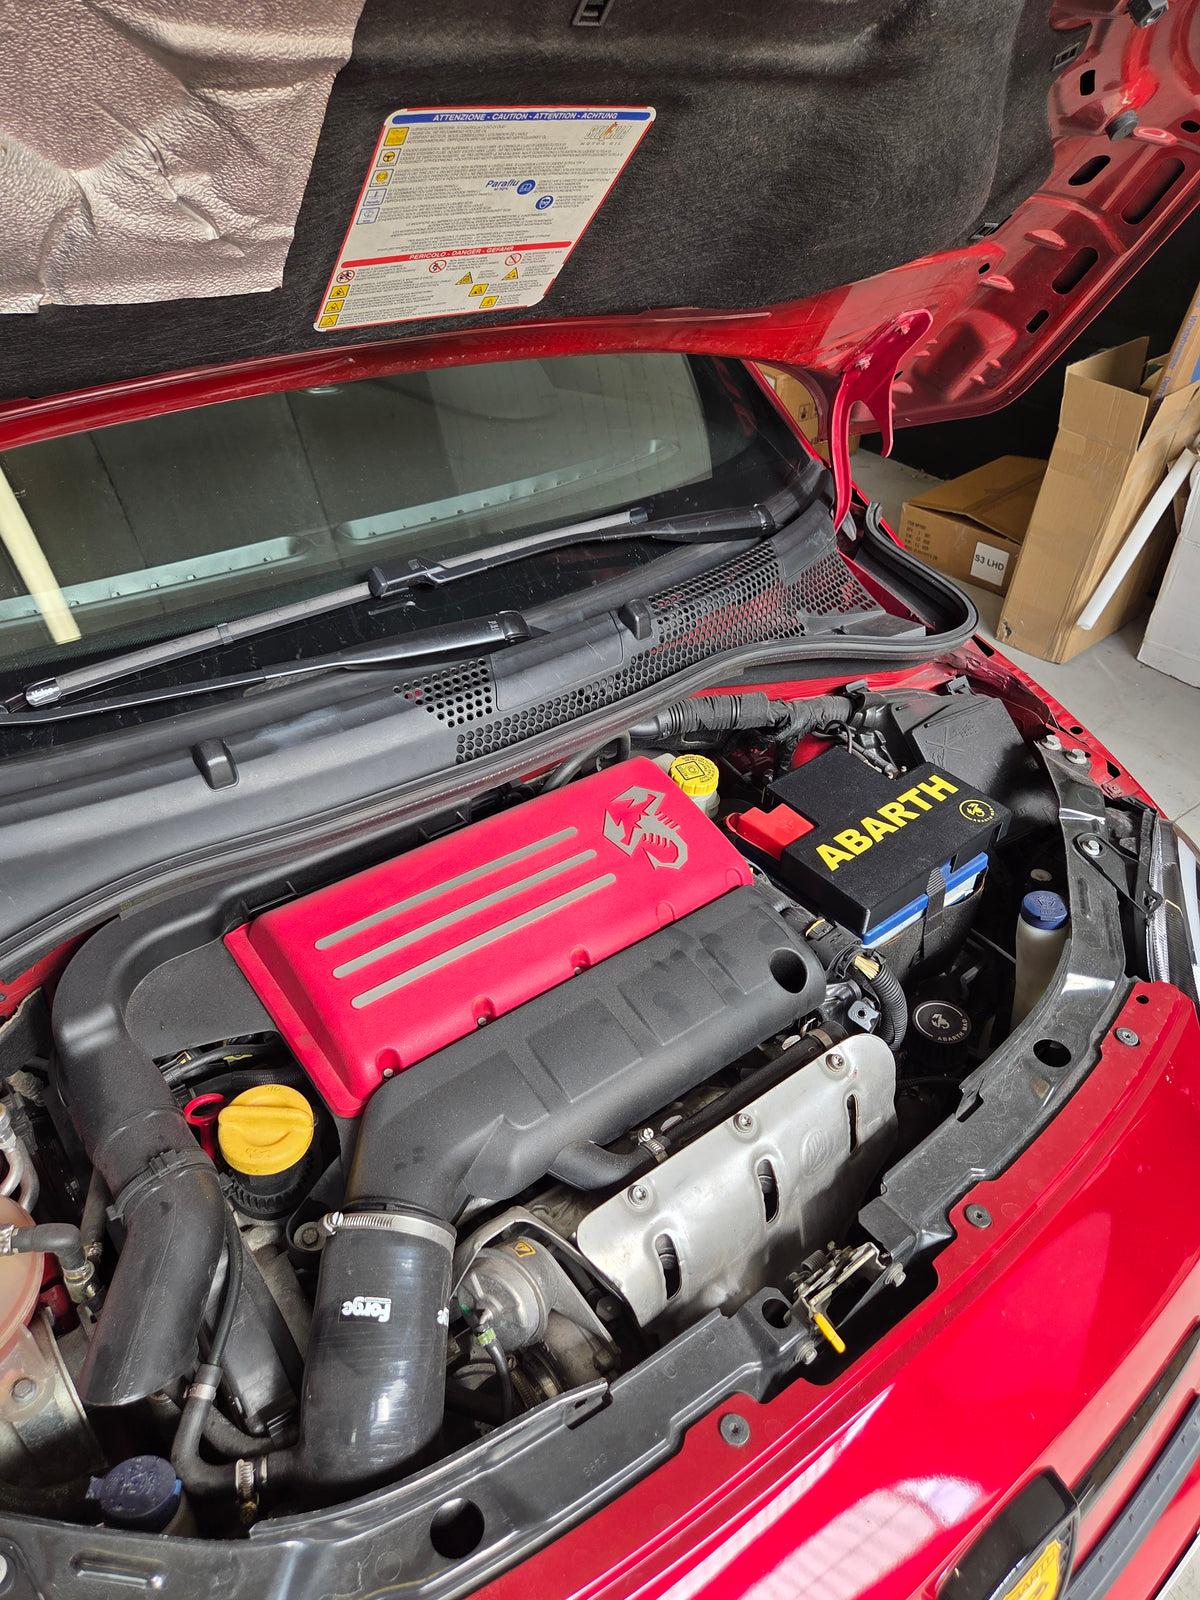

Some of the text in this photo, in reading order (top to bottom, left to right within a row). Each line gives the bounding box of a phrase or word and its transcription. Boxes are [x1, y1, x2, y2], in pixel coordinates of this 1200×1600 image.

[433, 113, 486, 121] ATTENZIONE
[491, 112, 528, 121] CAUTION
[533, 112, 577, 120] ATTENTION
[485, 179, 520, 188] Paraflu
[409, 246, 514, 260] PERICOLO DANGER GEFAHR
[974, 554, 1005, 572] S3 LHD
[815, 774, 960, 872] ABARTH
[937, 1032, 965, 1042] ABARTH
[341, 1296, 391, 1323] Forge
